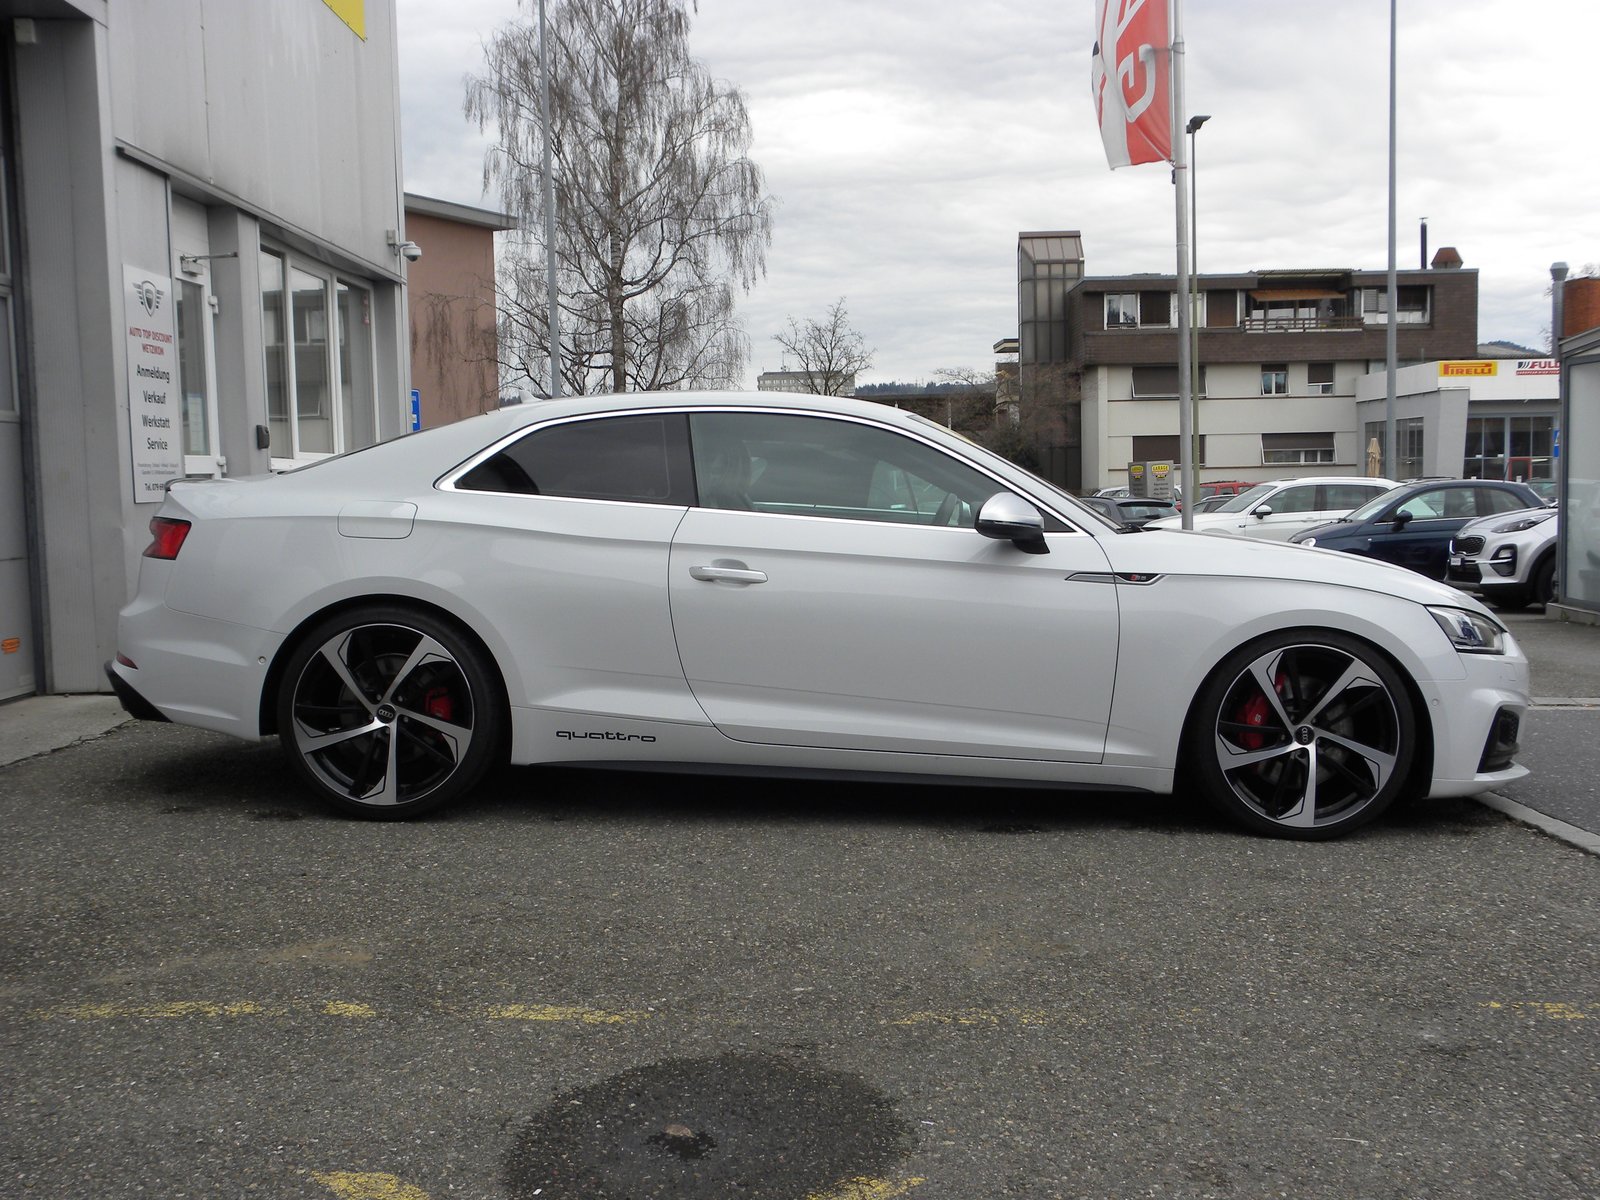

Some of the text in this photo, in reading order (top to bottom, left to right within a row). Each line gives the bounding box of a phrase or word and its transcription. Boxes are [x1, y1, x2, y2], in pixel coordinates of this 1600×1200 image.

[1443, 363, 1492, 375] PIRELLI
[1530, 361, 1560, 369] FULD
[136, 364, 170, 384] Anmeldung
[143, 390, 166, 405] Verkauf
[142, 414, 170, 429] Werkstatt
[147, 438, 168, 450] Service
[556, 731, 656, 743] quattro
